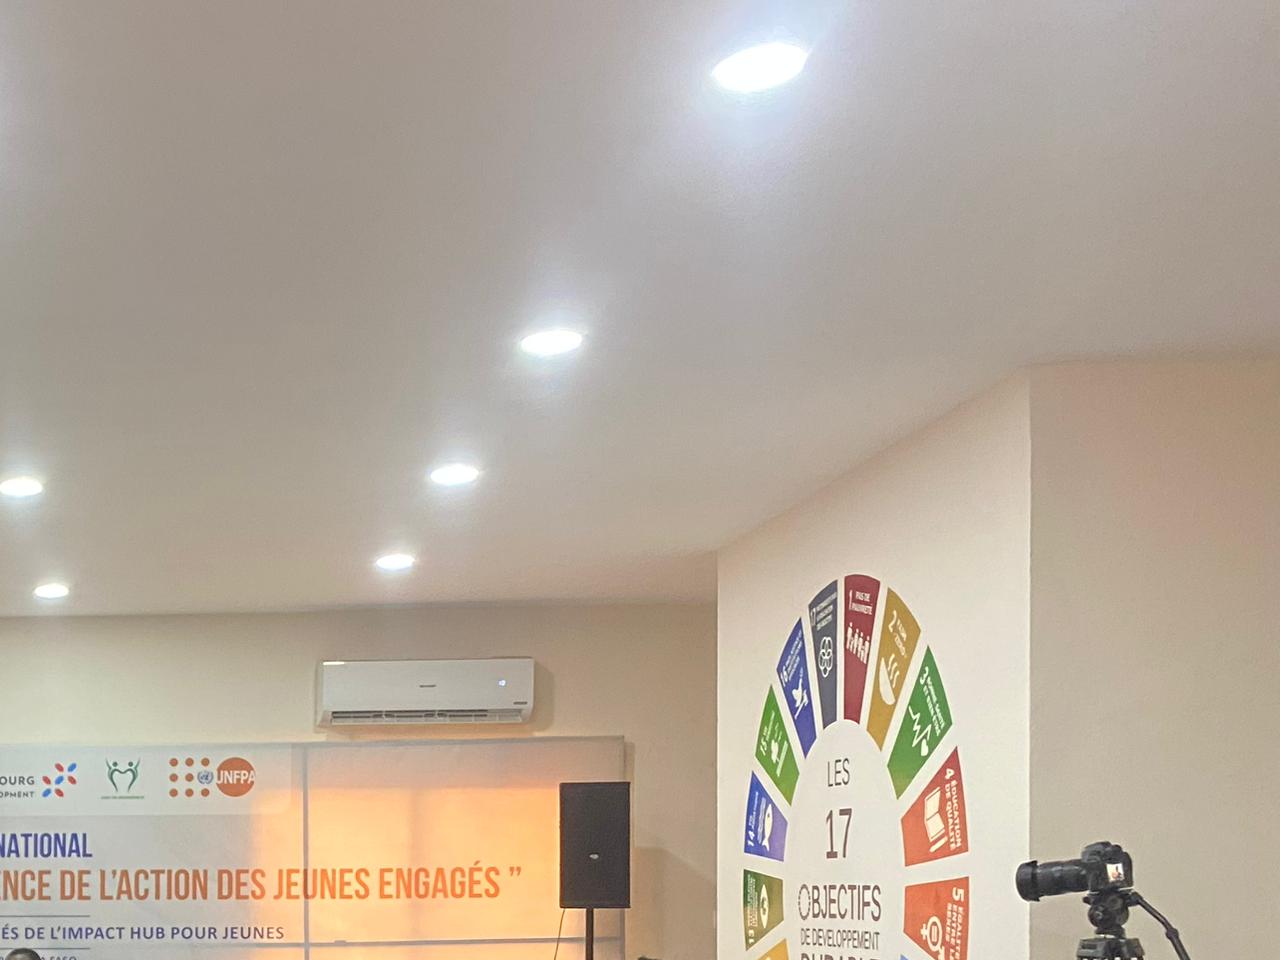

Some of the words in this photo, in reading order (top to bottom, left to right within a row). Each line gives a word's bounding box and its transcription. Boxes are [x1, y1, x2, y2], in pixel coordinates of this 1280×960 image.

[888, 609, 897, 633] 2
[920, 666, 929, 685] 3
[216, 770, 256, 784] UNFPA
[827, 758, 850, 788] LES
[945, 768, 955, 779] 4
[826, 808, 852, 859] 17
[60, 869, 91, 900] DE
[99, 868, 208, 901] L’ACTION
[217, 868, 265, 900] DES
[273, 867, 370, 900] JEUNES
[379, 860, 500, 900] ENGAGÉS
[798, 883, 882, 922] OBJECTIFS
[952, 887, 965, 902] 5
[24, 927, 45, 940] DE
[50, 926, 125, 940] L’IMPACT
[130, 926, 166, 940] HUB
[171, 926, 217, 940] POUR
[222, 926, 284, 940] JEUNES
[800, 927, 811, 946] DE
